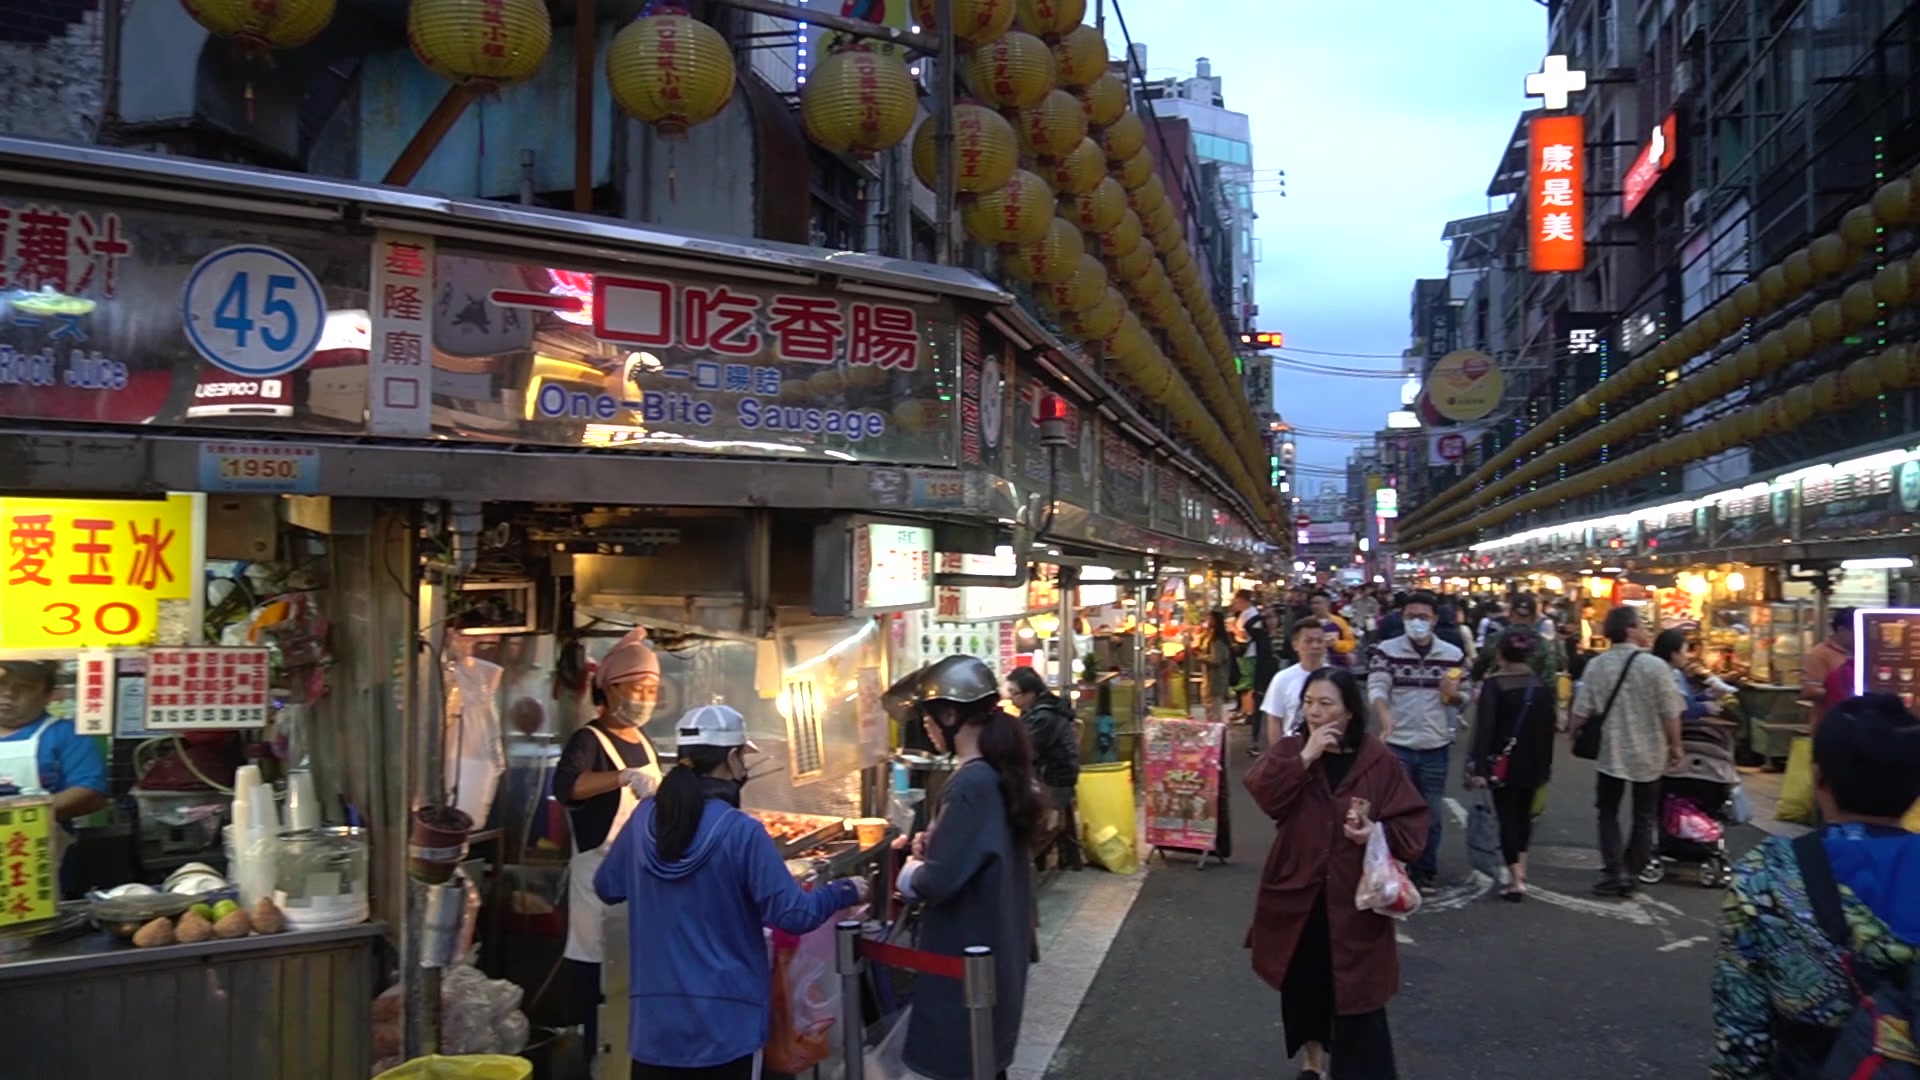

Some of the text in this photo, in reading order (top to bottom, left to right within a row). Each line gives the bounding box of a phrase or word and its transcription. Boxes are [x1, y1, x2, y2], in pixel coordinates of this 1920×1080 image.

[1540, 143, 1575, 242] 康是美
[214, 271, 298, 351] 45
[382, 240, 424, 410] 基隆廟口
[489, 273, 919, 371] 一口吃香腸
[63, 349, 128, 390] Juice
[538, 382, 885, 443] One-Bite Sausage
[227, 458, 293, 478] 1950
[8, 512, 176, 592] 愛玉冰
[41, 601, 141, 637] 30
